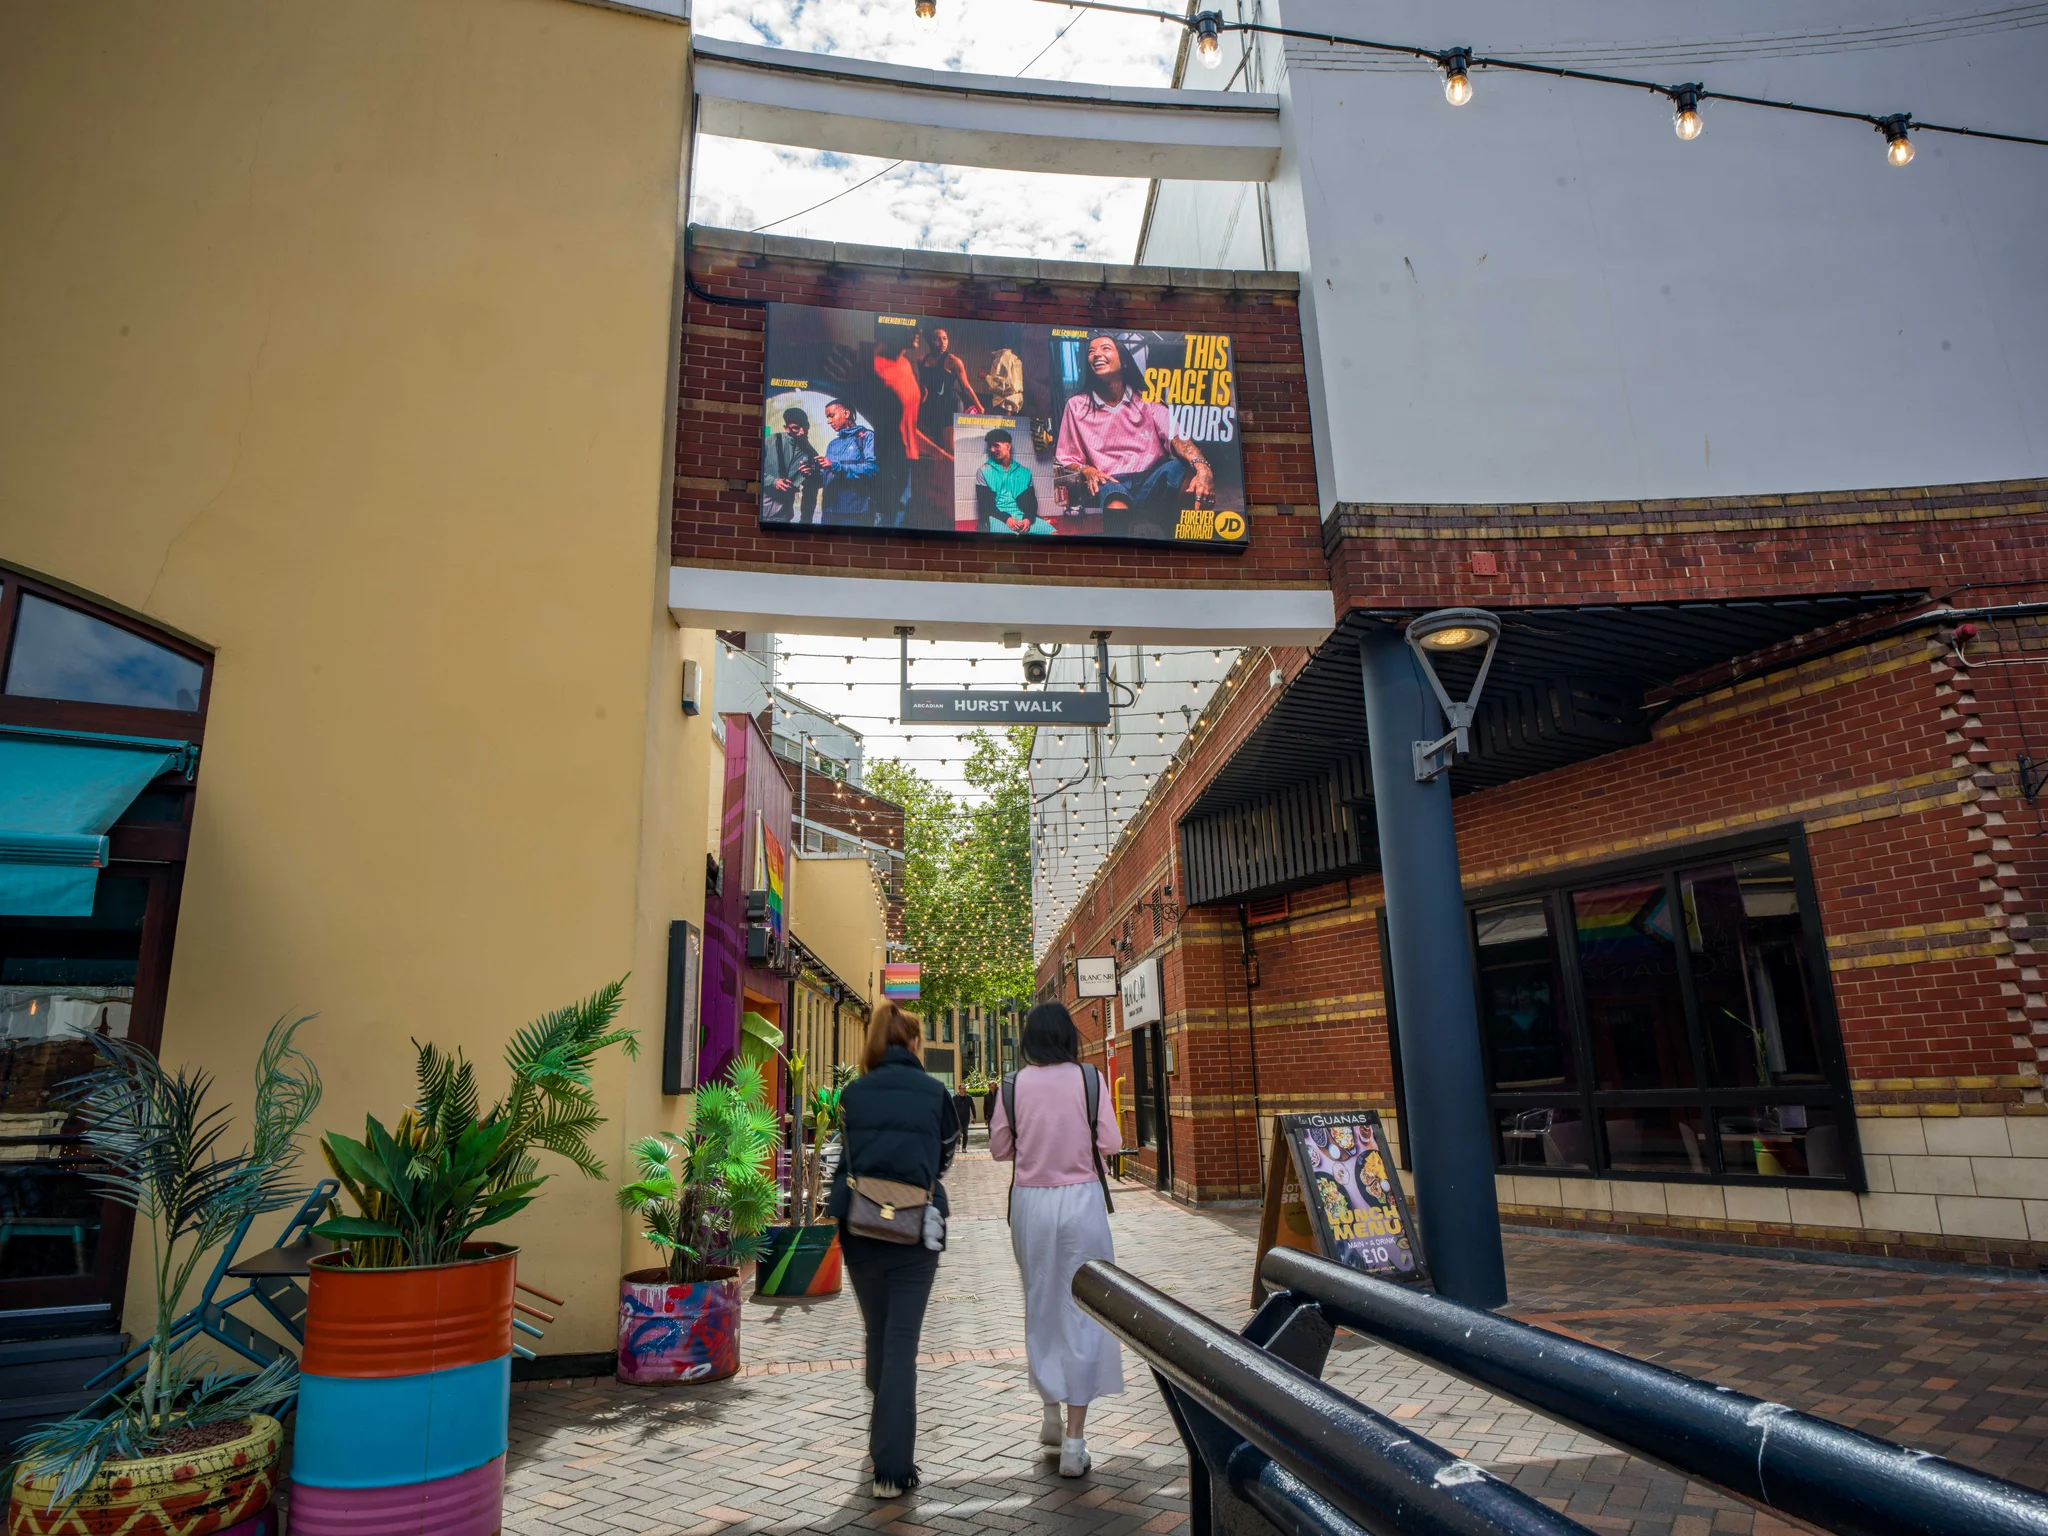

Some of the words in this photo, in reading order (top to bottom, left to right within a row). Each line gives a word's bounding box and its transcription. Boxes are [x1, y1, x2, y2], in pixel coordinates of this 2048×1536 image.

[1184, 334, 1230, 371] THIS
[1142, 367, 1209, 405] SPACE
[1210, 370, 1233, 406] IS
[1168, 404, 1236, 443] YOURS
[1181, 509, 1215, 525] FOREVER
[1219, 517, 1242, 533] JD
[1175, 523, 1214, 540] FORWARD
[954, 699, 1010, 712] HURST
[1014, 700, 1063, 713] WALK
[1079, 973, 1103, 981] BLANC
[1308, 1114, 1368, 1127] IGUANAS
[1327, 1205, 1399, 1225] LUNCH
[1333, 1218, 1402, 1241] MENU
[1347, 1240, 1365, 1249] MAIN
[1370, 1239, 1376, 1247] A
[1376, 1236, 1396, 1246] DRINK
[1362, 1246, 1389, 1264] £10
